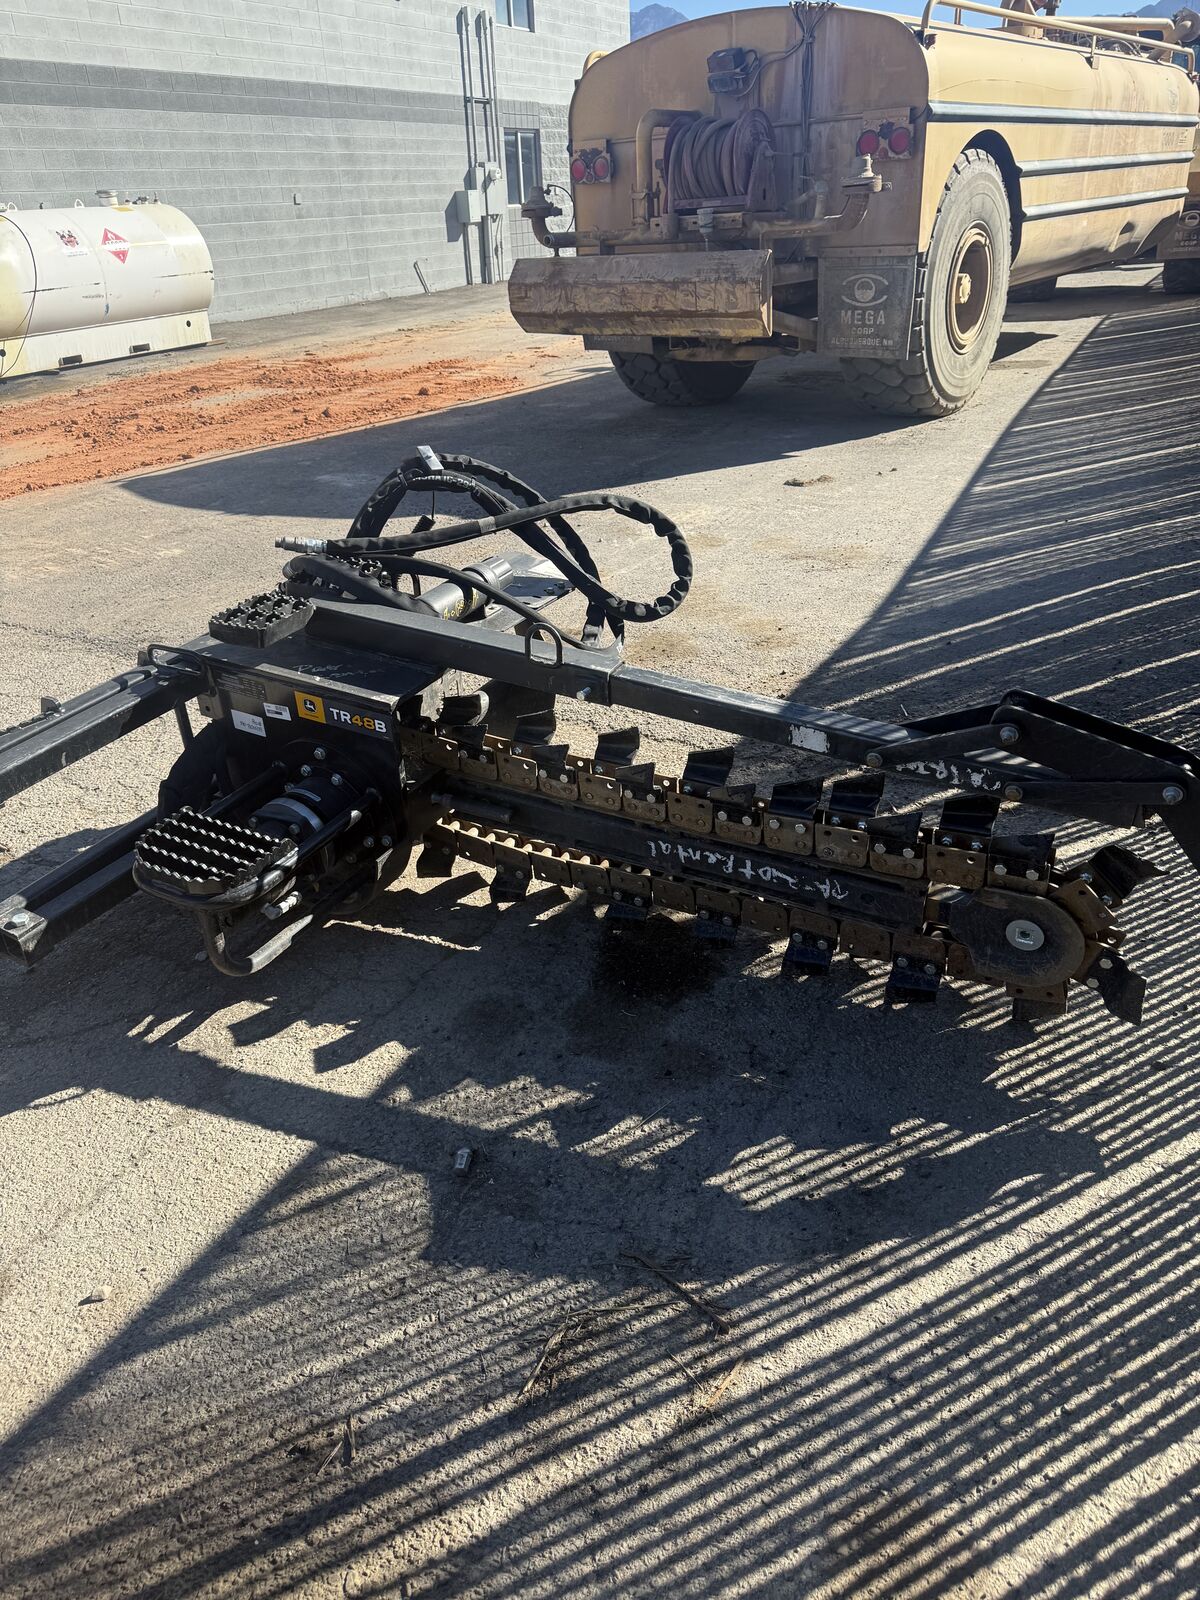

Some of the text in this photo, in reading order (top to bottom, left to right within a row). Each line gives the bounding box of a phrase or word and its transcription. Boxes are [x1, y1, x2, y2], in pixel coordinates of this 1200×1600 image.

[840, 310, 885, 325] MEGA
[851, 327, 875, 335] CORP
[330, 707, 387, 733] TR48B
